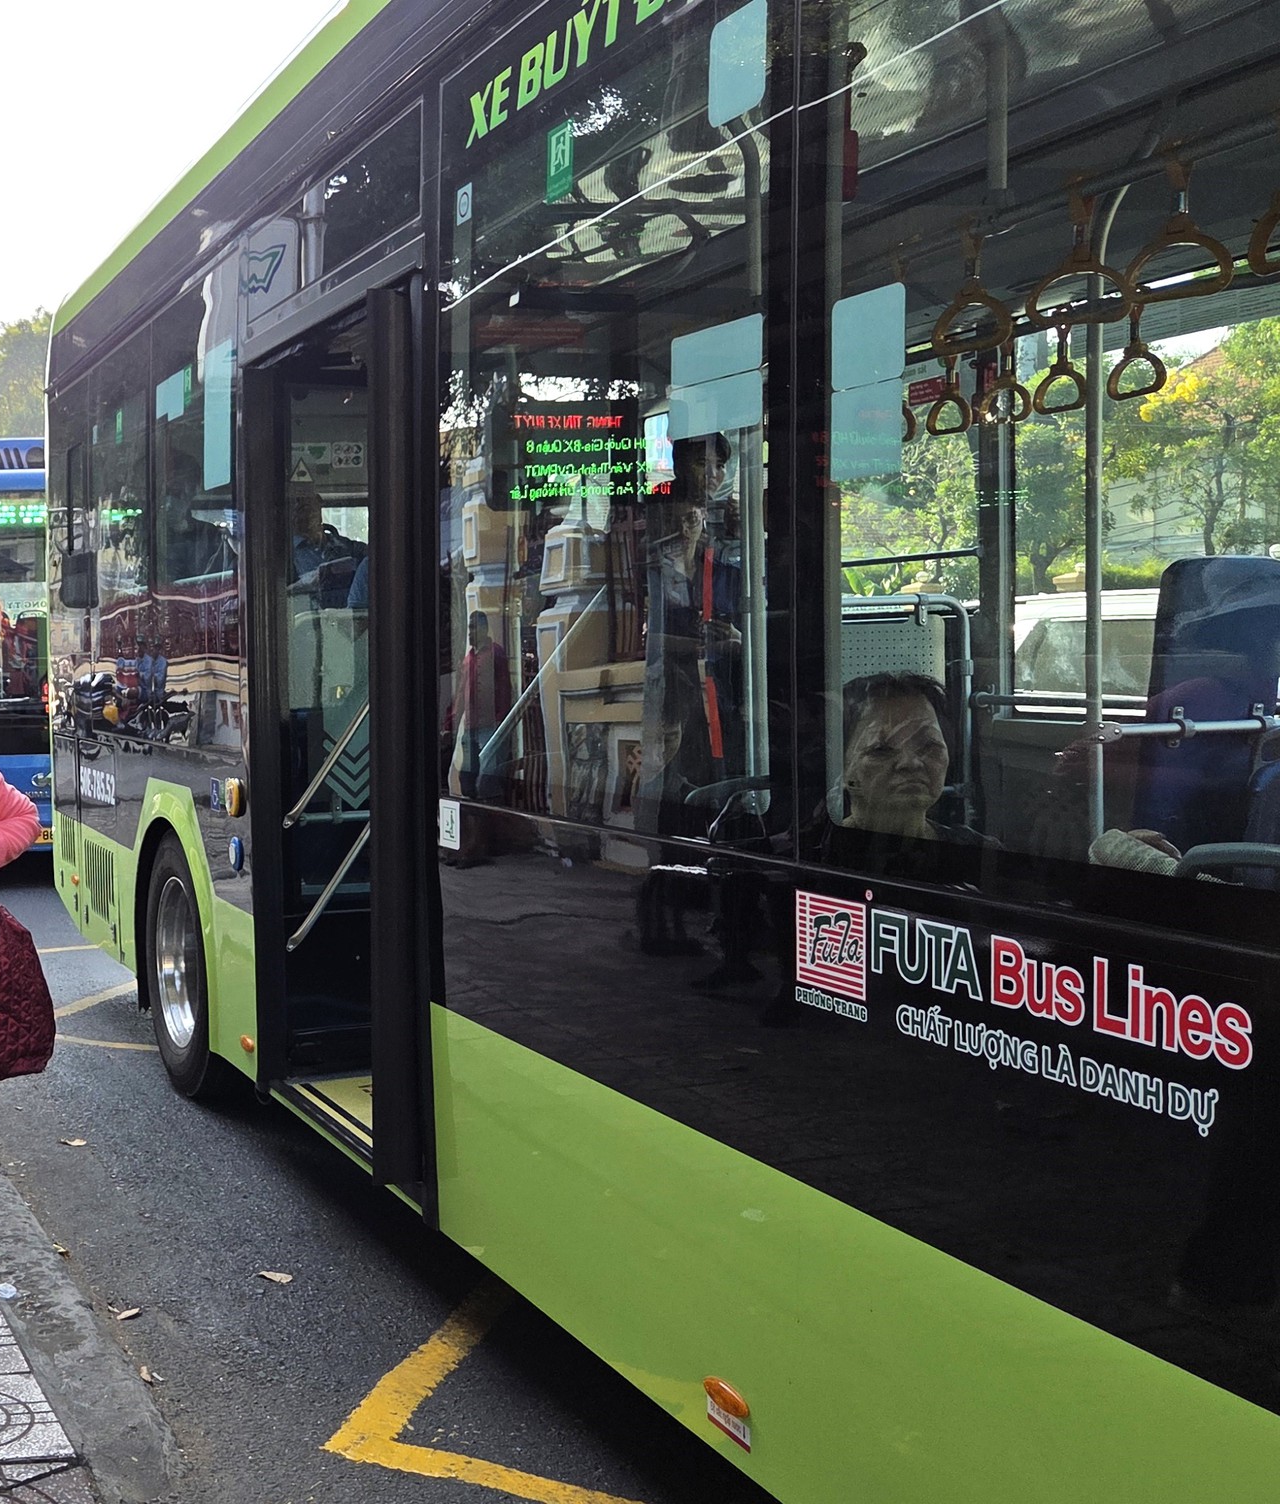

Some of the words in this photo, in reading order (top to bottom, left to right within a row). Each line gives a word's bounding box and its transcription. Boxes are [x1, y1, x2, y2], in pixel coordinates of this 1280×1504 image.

[466, 66, 512, 149] XE
[795, 986, 833, 1012] PHƯƠNG
[833, 998, 868, 1022] TRANG
[870, 908, 983, 1002] FUTA
[990, 933, 1084, 1027] Bus
[1093, 956, 1253, 1070] Lines
[896, 1004, 952, 1048] CHẤT
[954, 1020, 1038, 1071] LƯỢNG
[1041, 1043, 1077, 1087] LÀ
[1080, 1056, 1163, 1114] DANH
[1168, 1082, 1219, 1138] DỰ
